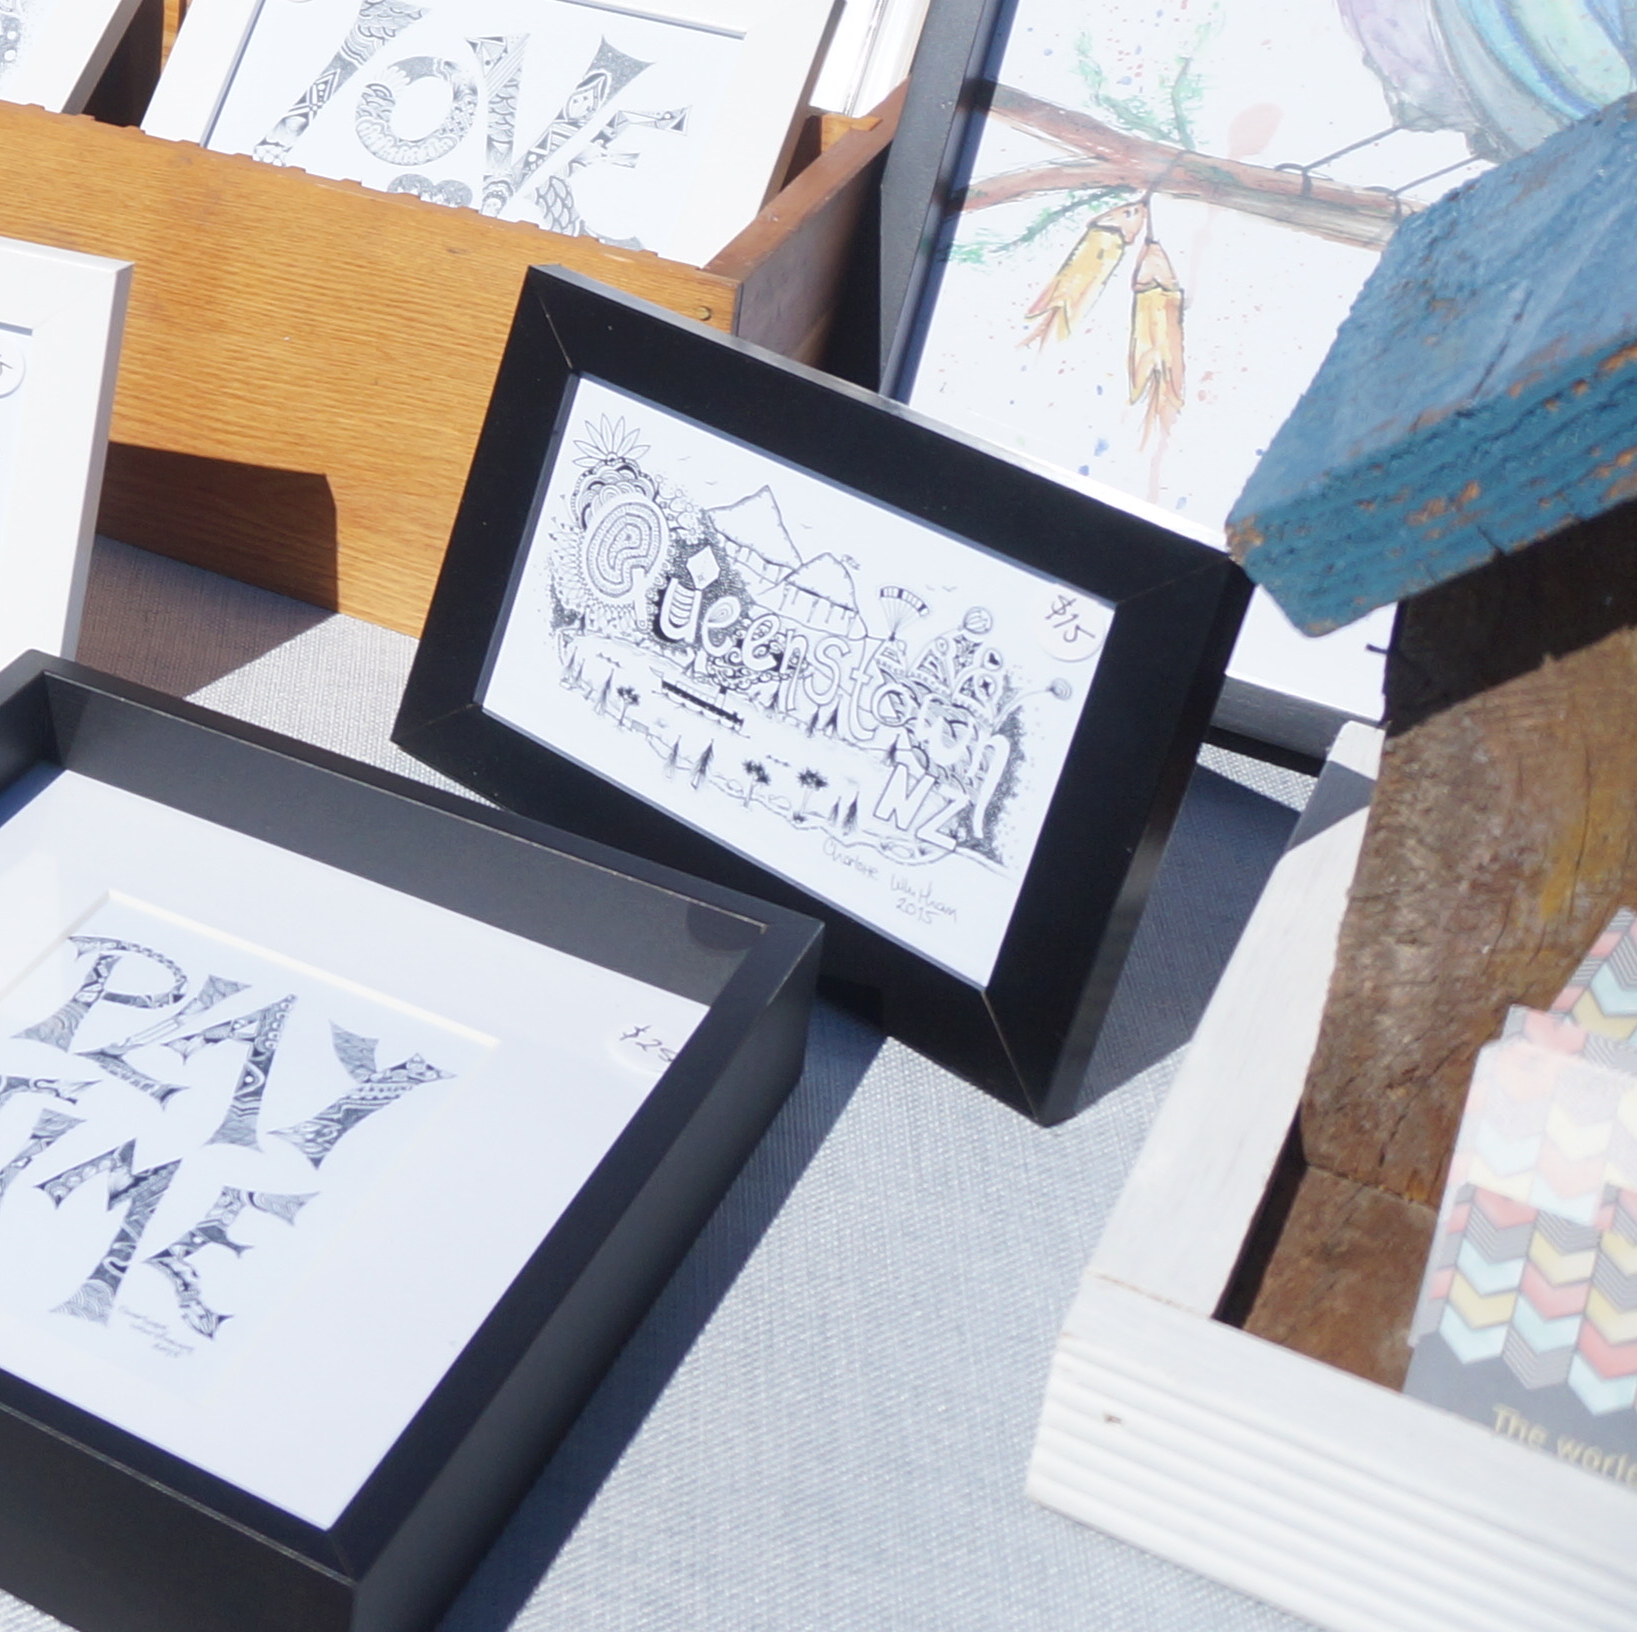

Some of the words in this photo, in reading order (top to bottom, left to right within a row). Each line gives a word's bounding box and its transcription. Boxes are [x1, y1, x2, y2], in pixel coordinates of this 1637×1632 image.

[1046, 595, 1096, 646] $15
[870, 760, 960, 852] NZ
[895, 897, 940, 925] 2015
[11, 932, 456, 1172] PLAY
[1492, 1402, 1549, 1448] The
